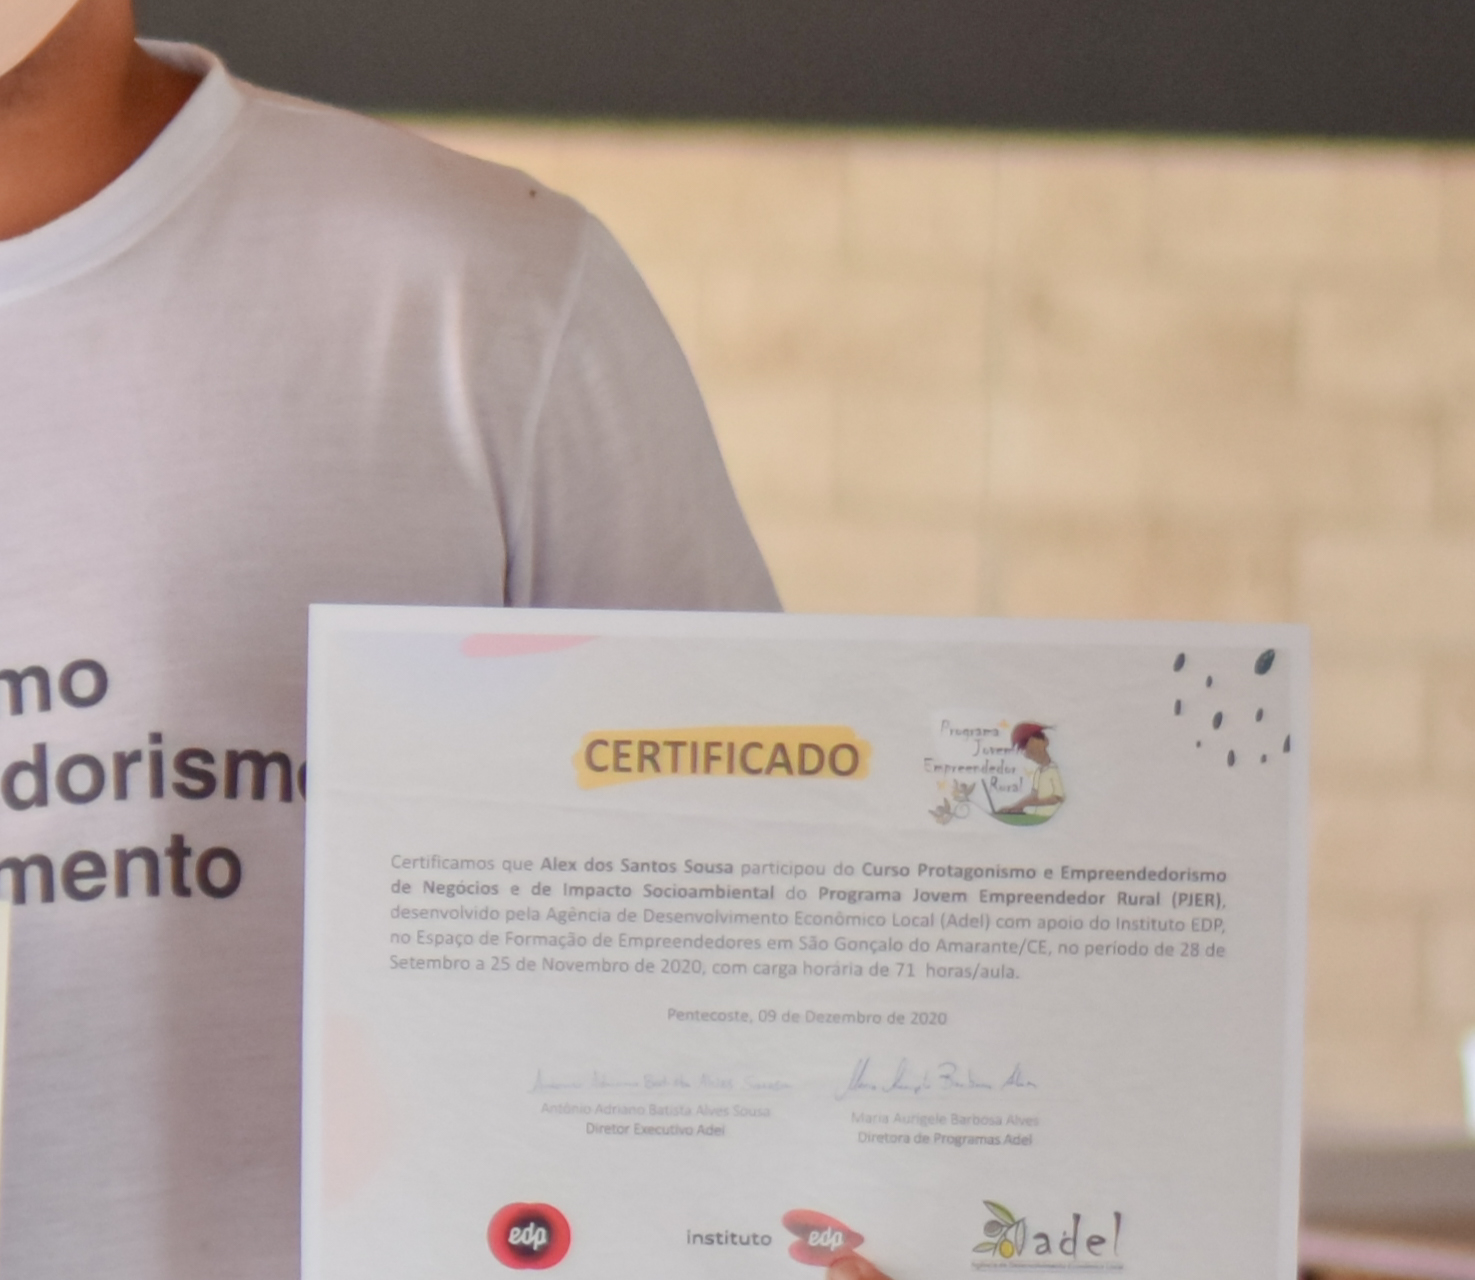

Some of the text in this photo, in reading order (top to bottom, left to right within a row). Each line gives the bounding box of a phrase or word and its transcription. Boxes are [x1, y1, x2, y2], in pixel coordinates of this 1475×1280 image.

[584, 738, 860, 777] CERTIFICADO
[390, 853, 1228, 884] Certificamos que Alex dos Santos Sousa participou do Curso Protagonismo e Empreendedorismo
[686, 1228, 773, 1247] instituto
[1032, 1210, 1122, 1260] adel
